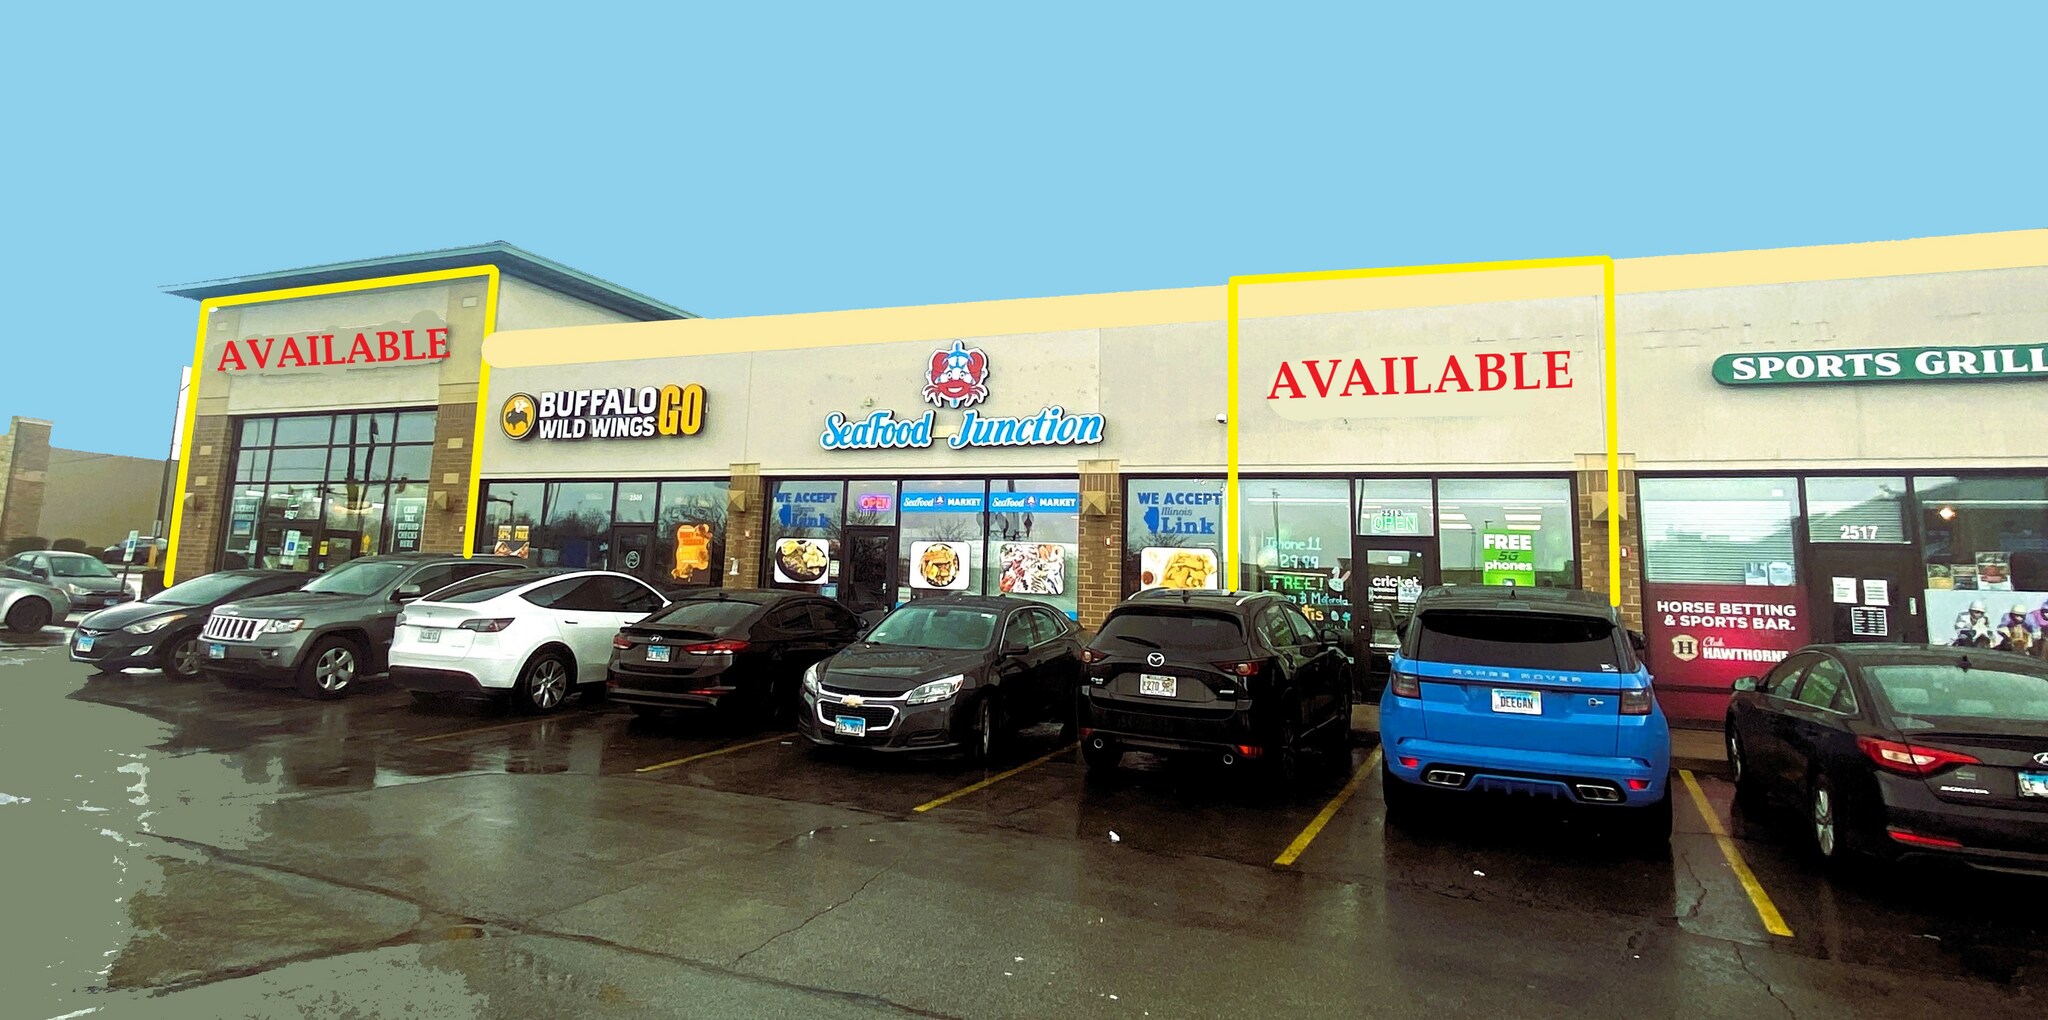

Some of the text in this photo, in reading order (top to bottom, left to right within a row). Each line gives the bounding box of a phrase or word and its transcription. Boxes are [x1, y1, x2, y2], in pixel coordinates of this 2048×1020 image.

[1732, 348, 2048, 381] SPORTS GRILL
[539, 386, 659, 418] BUFFALO
[658, 383, 704, 436] GO
[539, 416, 656, 439] WILD WINGS
[819, 405, 1106, 449] SeaFood Junction
[775, 492, 837, 503] WE ACCEPT
[862, 496, 890, 509] OPEN
[903, 496, 982, 508] SeaFood MARKET
[992, 496, 1077, 508] SeaFood MARKET
[1137, 492, 1223, 505] WE ACCEPT
[1161, 507, 1193, 516] Illinois
[1382, 509, 1402, 517] 2513
[792, 513, 829, 528] Link
[1161, 517, 1216, 534] Link
[1373, 516, 1417, 531] OPEN
[1840, 525, 1879, 540] 2517
[1483, 533, 1532, 550] FREE
[1279, 553, 1319, 569] 29.99
[1498, 551, 1519, 561] 5G
[1484, 559, 1533, 572] phones
[1372, 575, 1420, 588] cricket
[1656, 600, 1797, 617] HORSE BETTING
[1664, 614, 1796, 631] & SPORTS BAR.
[1678, 640, 1694, 655] H
[1703, 636, 1725, 647] Club
[1452, 668, 1582, 683] RANGE ROVER
[1500, 696, 1534, 709] DEEGAN
